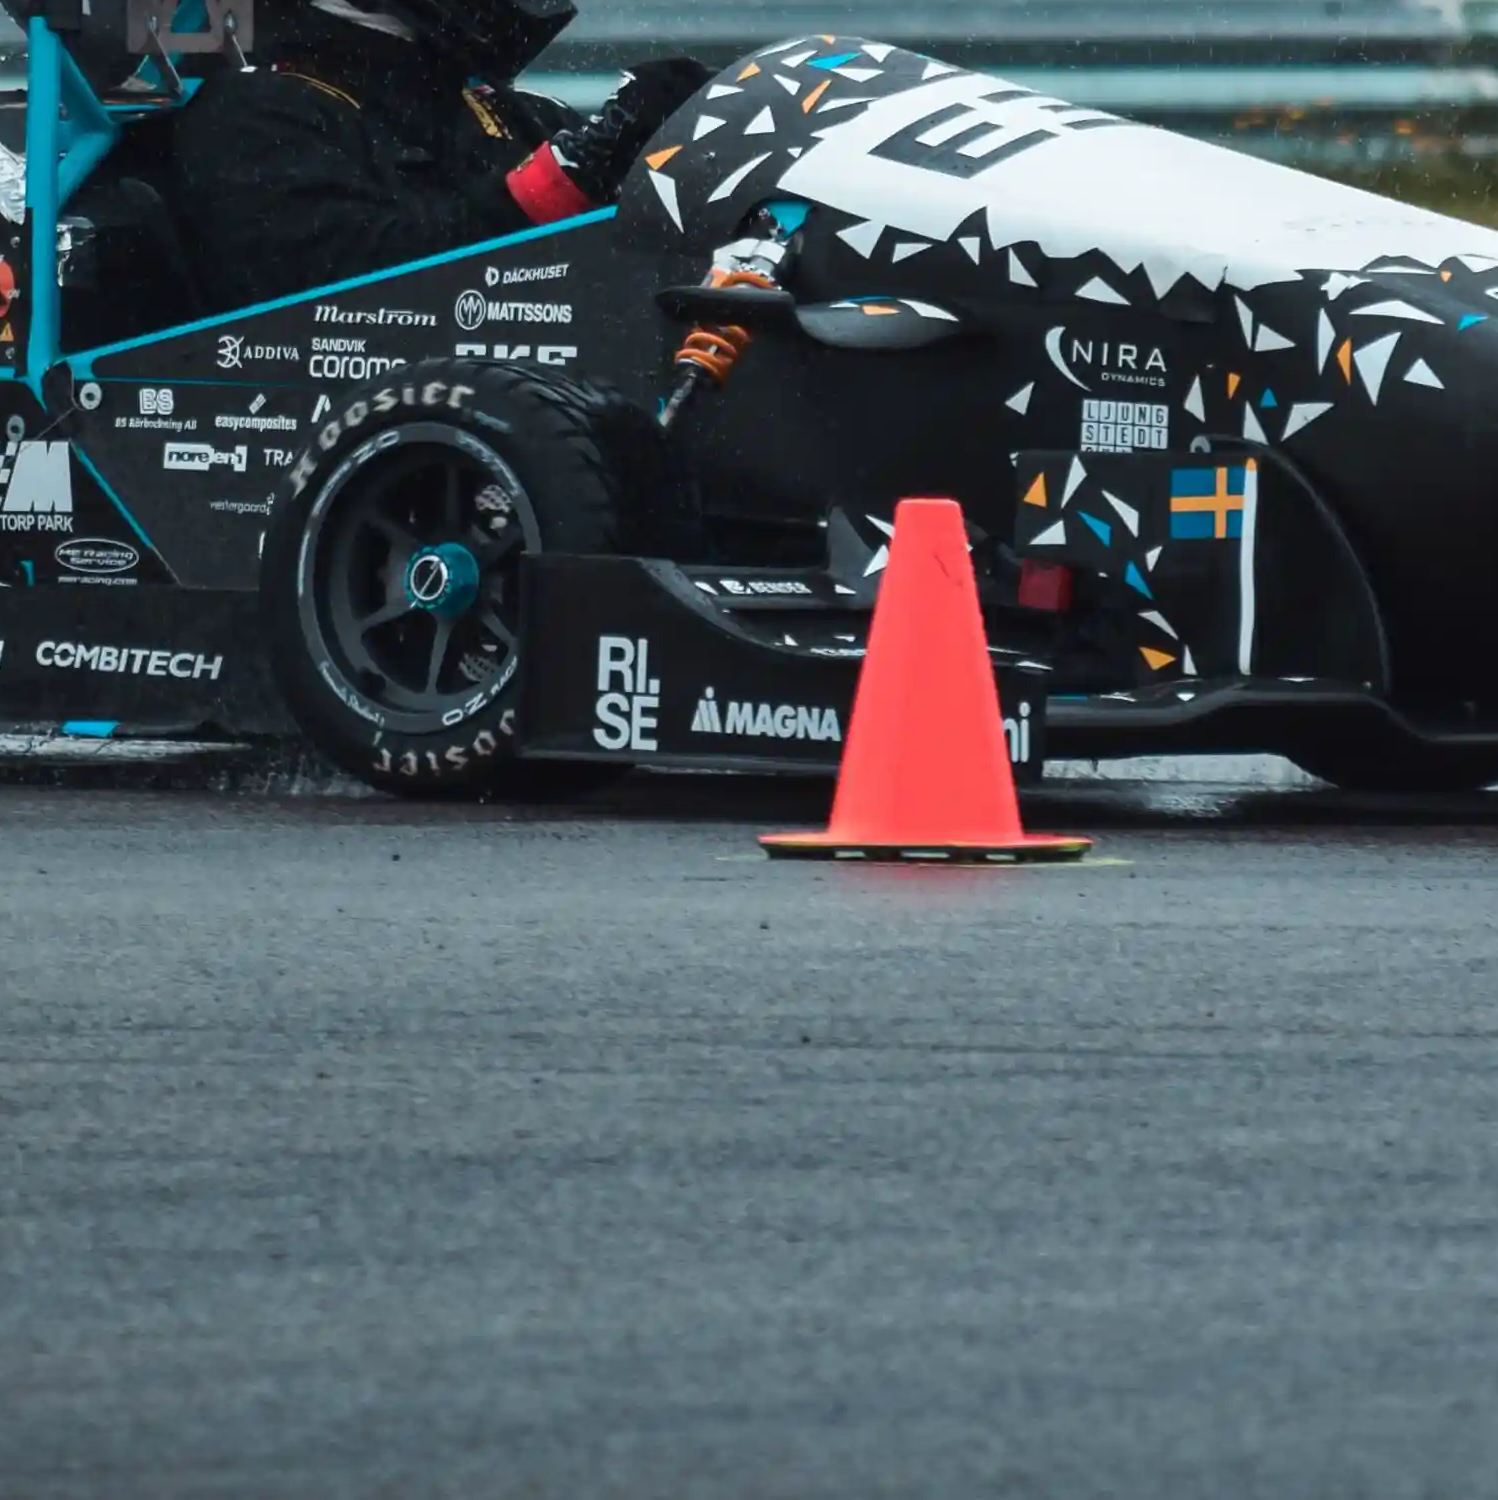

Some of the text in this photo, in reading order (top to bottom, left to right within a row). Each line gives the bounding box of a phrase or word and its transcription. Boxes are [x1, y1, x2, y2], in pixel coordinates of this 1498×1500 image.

[486, 300, 573, 325] MATTSSONS
[243, 345, 300, 361] ADDIVA
[311, 337, 367, 353] SANDVIK
[1071, 338, 1168, 373] NIRA
[1100, 372, 1167, 387] DYNAMICS
[139, 388, 175, 416] BS
[1084, 401, 1168, 425] LJUNG
[214, 415, 298, 433] easycomposites
[1083, 423, 1167, 448] STEDT
[37, 514, 74, 533] PARK
[35, 639, 224, 681] COMBITECH
[592, 693, 660, 752] SE
[725, 701, 842, 743] MAGNA
